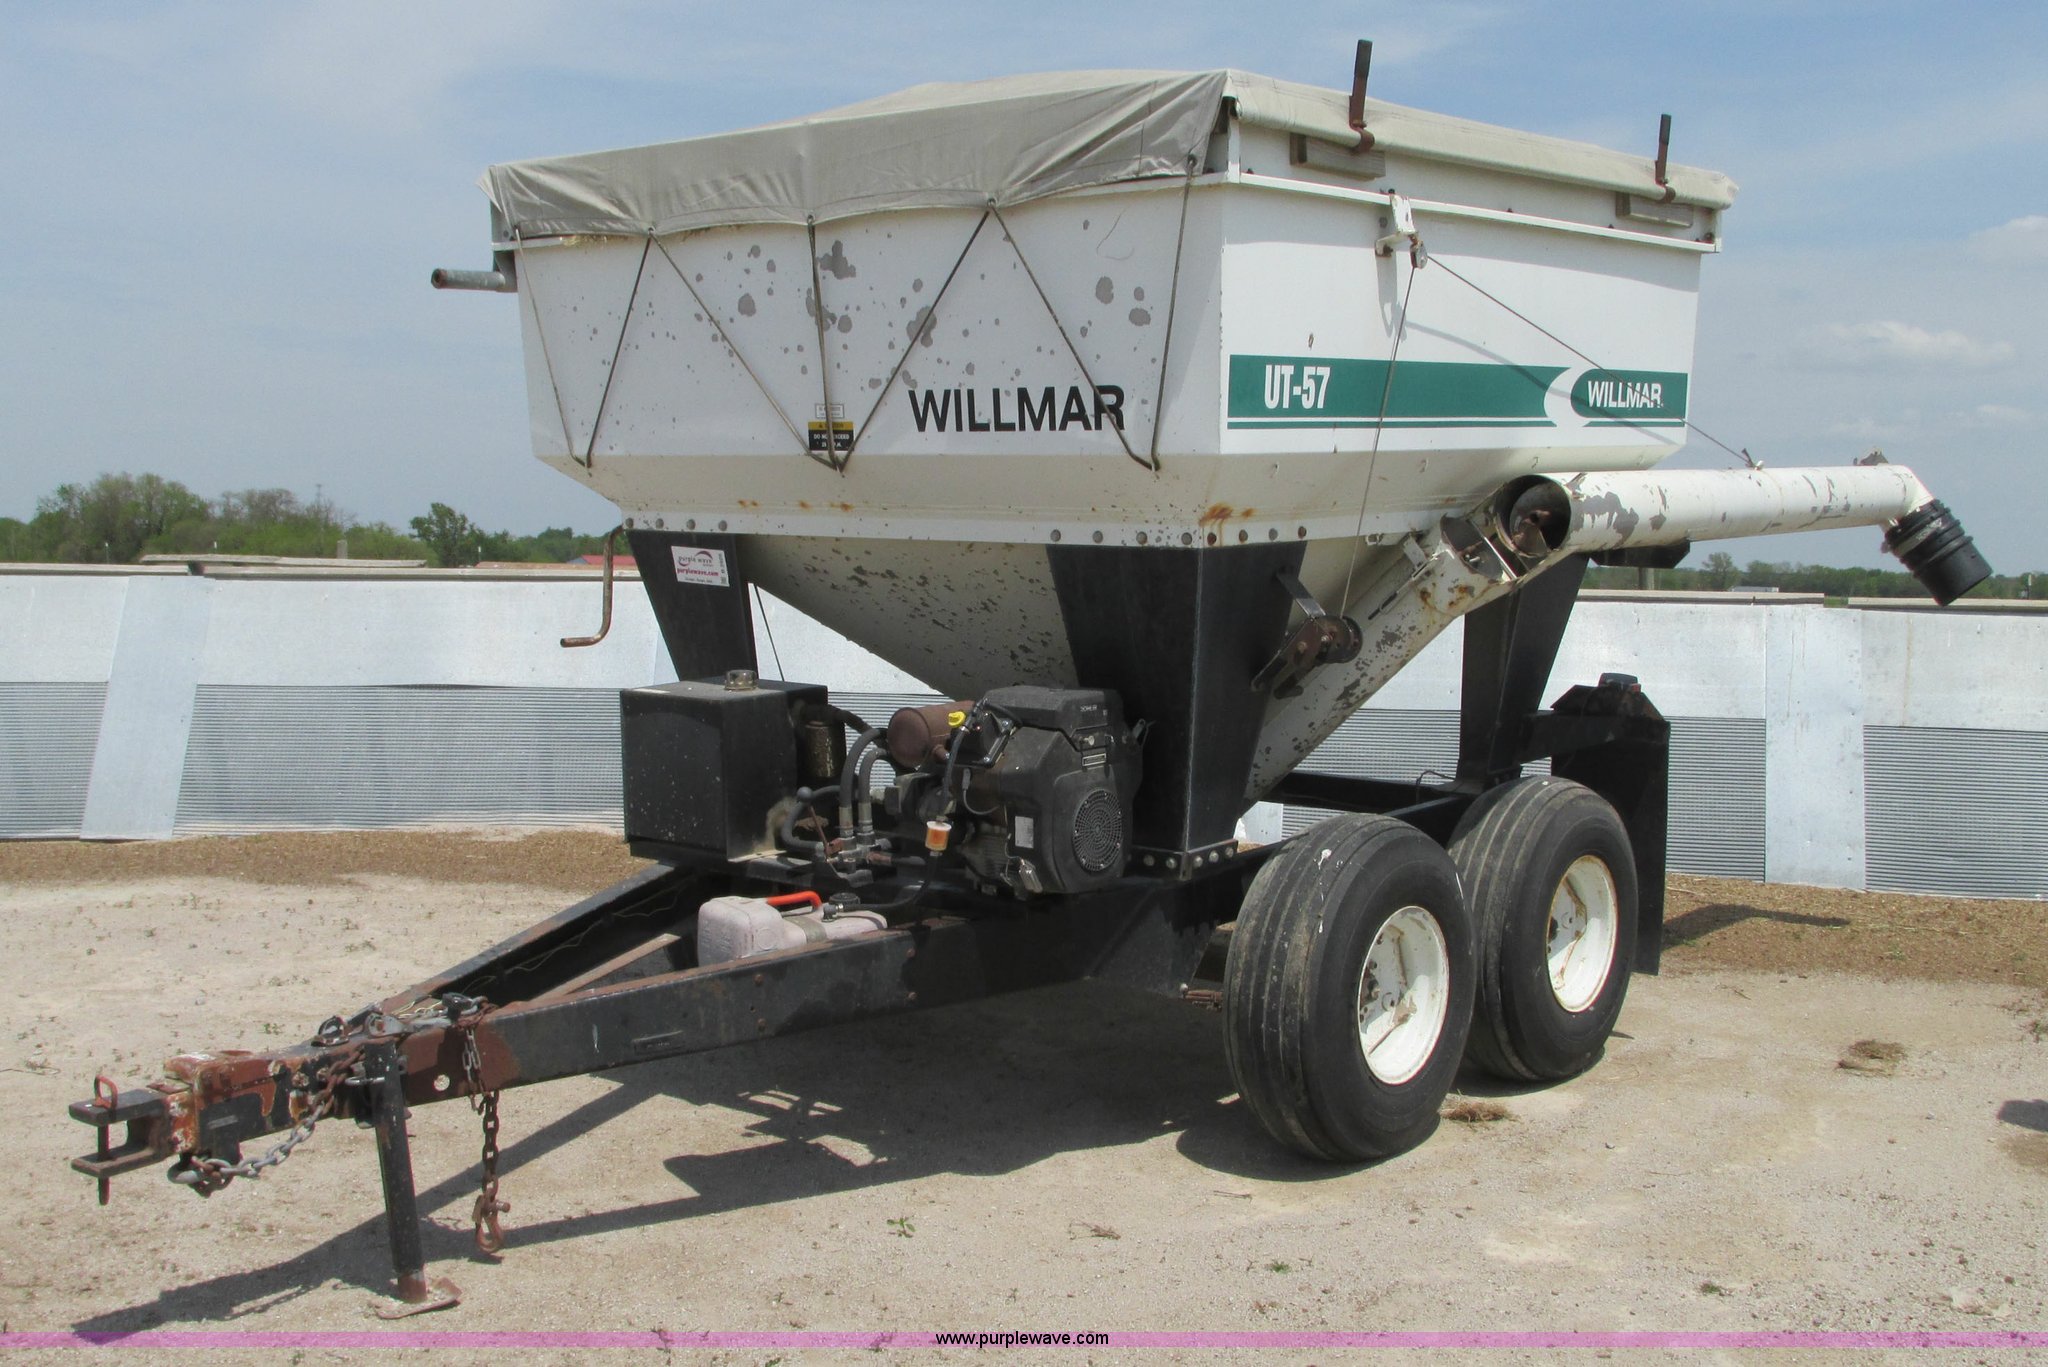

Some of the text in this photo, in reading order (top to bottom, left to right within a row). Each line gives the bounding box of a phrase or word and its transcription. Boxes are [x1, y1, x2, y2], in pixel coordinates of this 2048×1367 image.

[1264, 364, 1331, 410] UT-57
[1587, 380, 1663, 408] WILLMAR
[908, 385, 1125, 432] WILLMAR
[677, 568, 719, 576] purplewave.com
